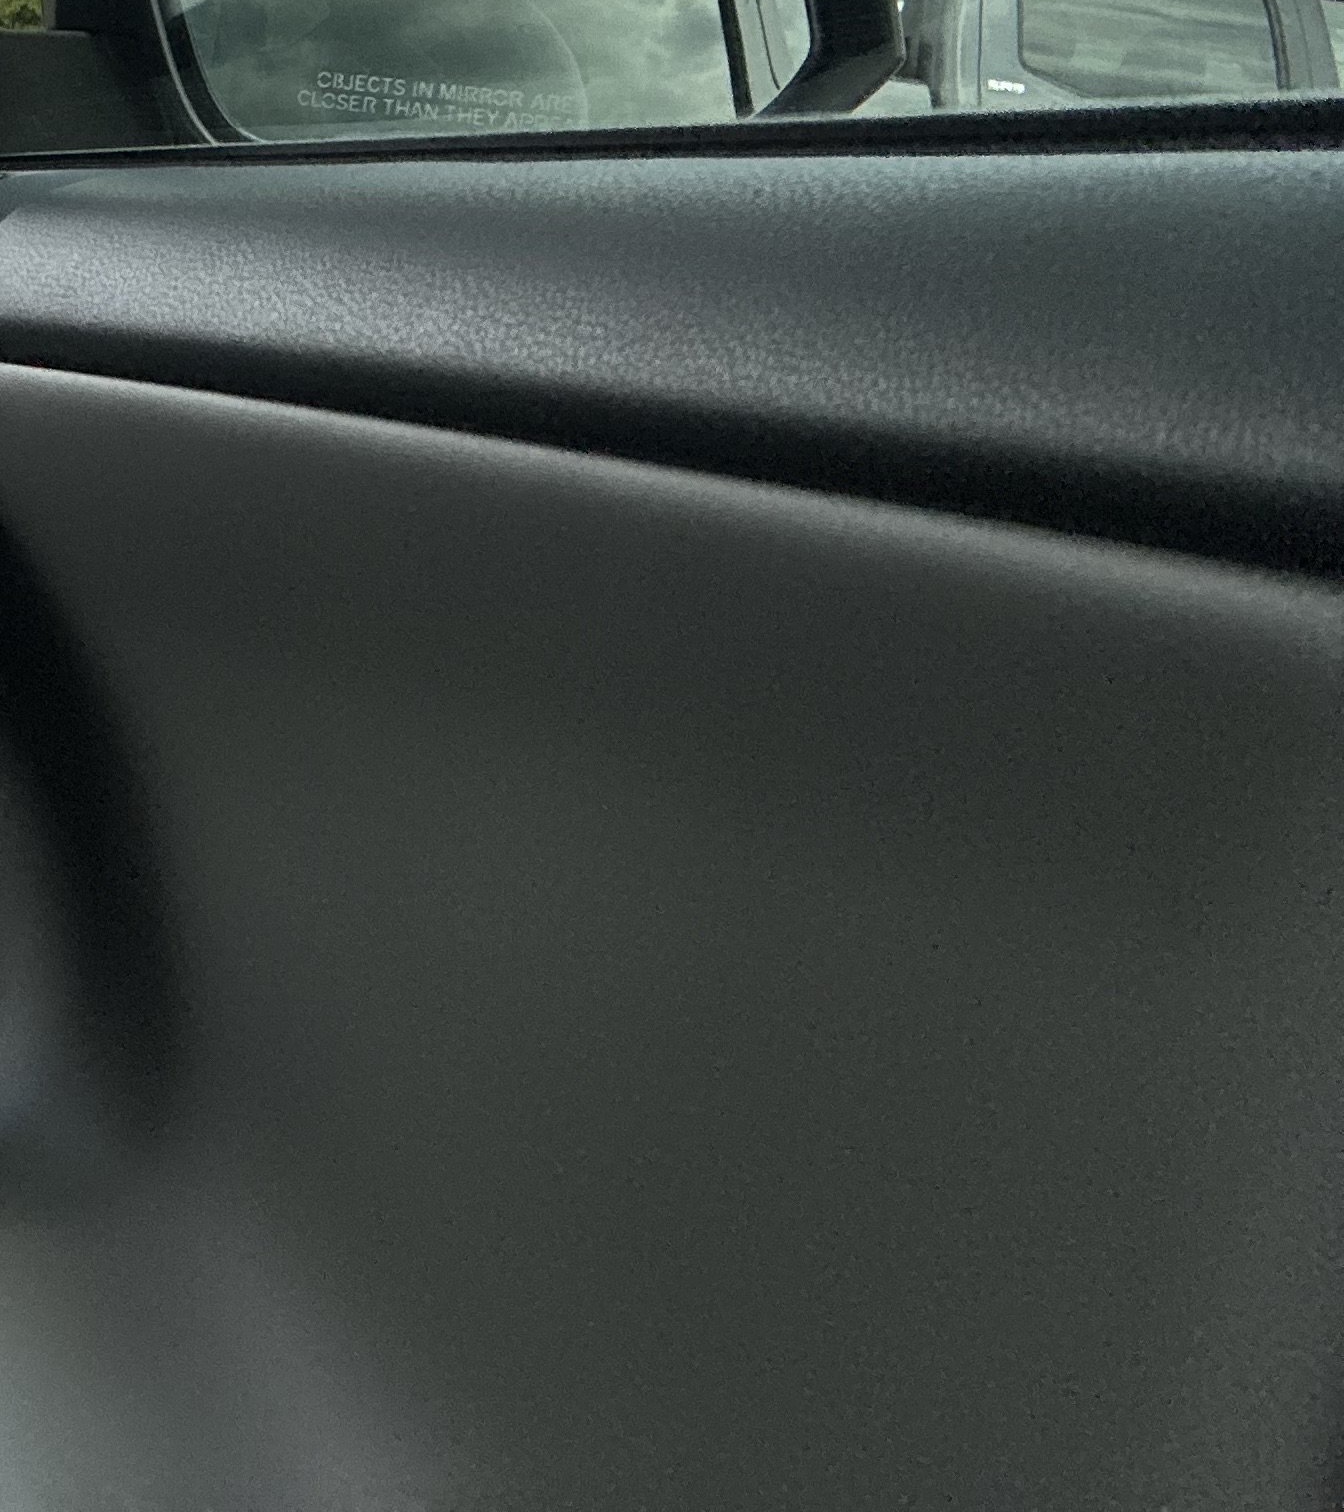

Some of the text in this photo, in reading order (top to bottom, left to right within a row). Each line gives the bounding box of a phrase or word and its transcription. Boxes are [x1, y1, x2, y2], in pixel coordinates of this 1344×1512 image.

[297, 89, 377, 114] CLOSER
[382, 98, 439, 121] THAN
[442, 104, 501, 127] THEY
[316, 71, 577, 113] OBJECTS IN MIRROR ARE
